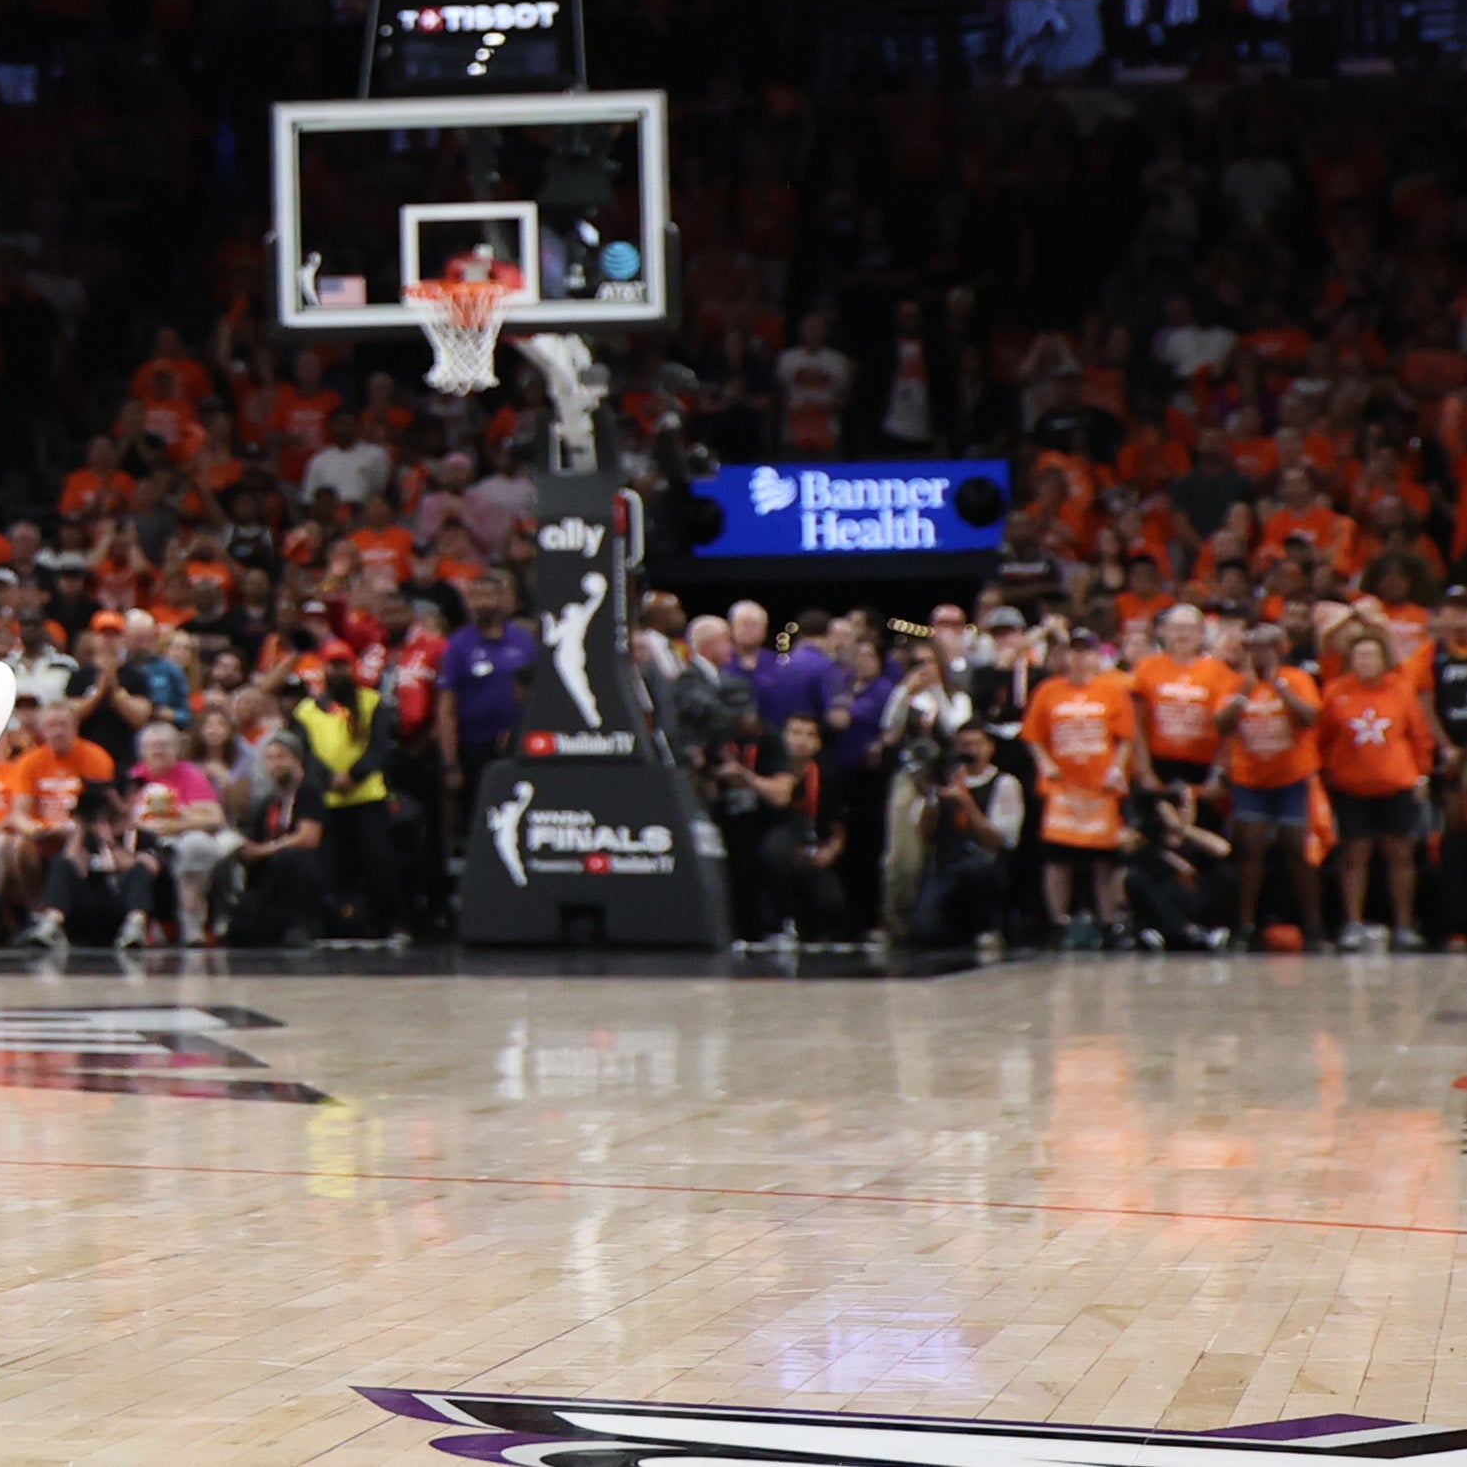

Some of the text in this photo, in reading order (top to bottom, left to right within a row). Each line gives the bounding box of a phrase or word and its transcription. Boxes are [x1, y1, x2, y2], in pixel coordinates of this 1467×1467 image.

[440, 0, 559, 33] TISSOT
[800, 470, 950, 509] Banner
[537, 516, 606, 558] ally
[801, 508, 937, 551] Health
[526, 824, 674, 854] FINALS
